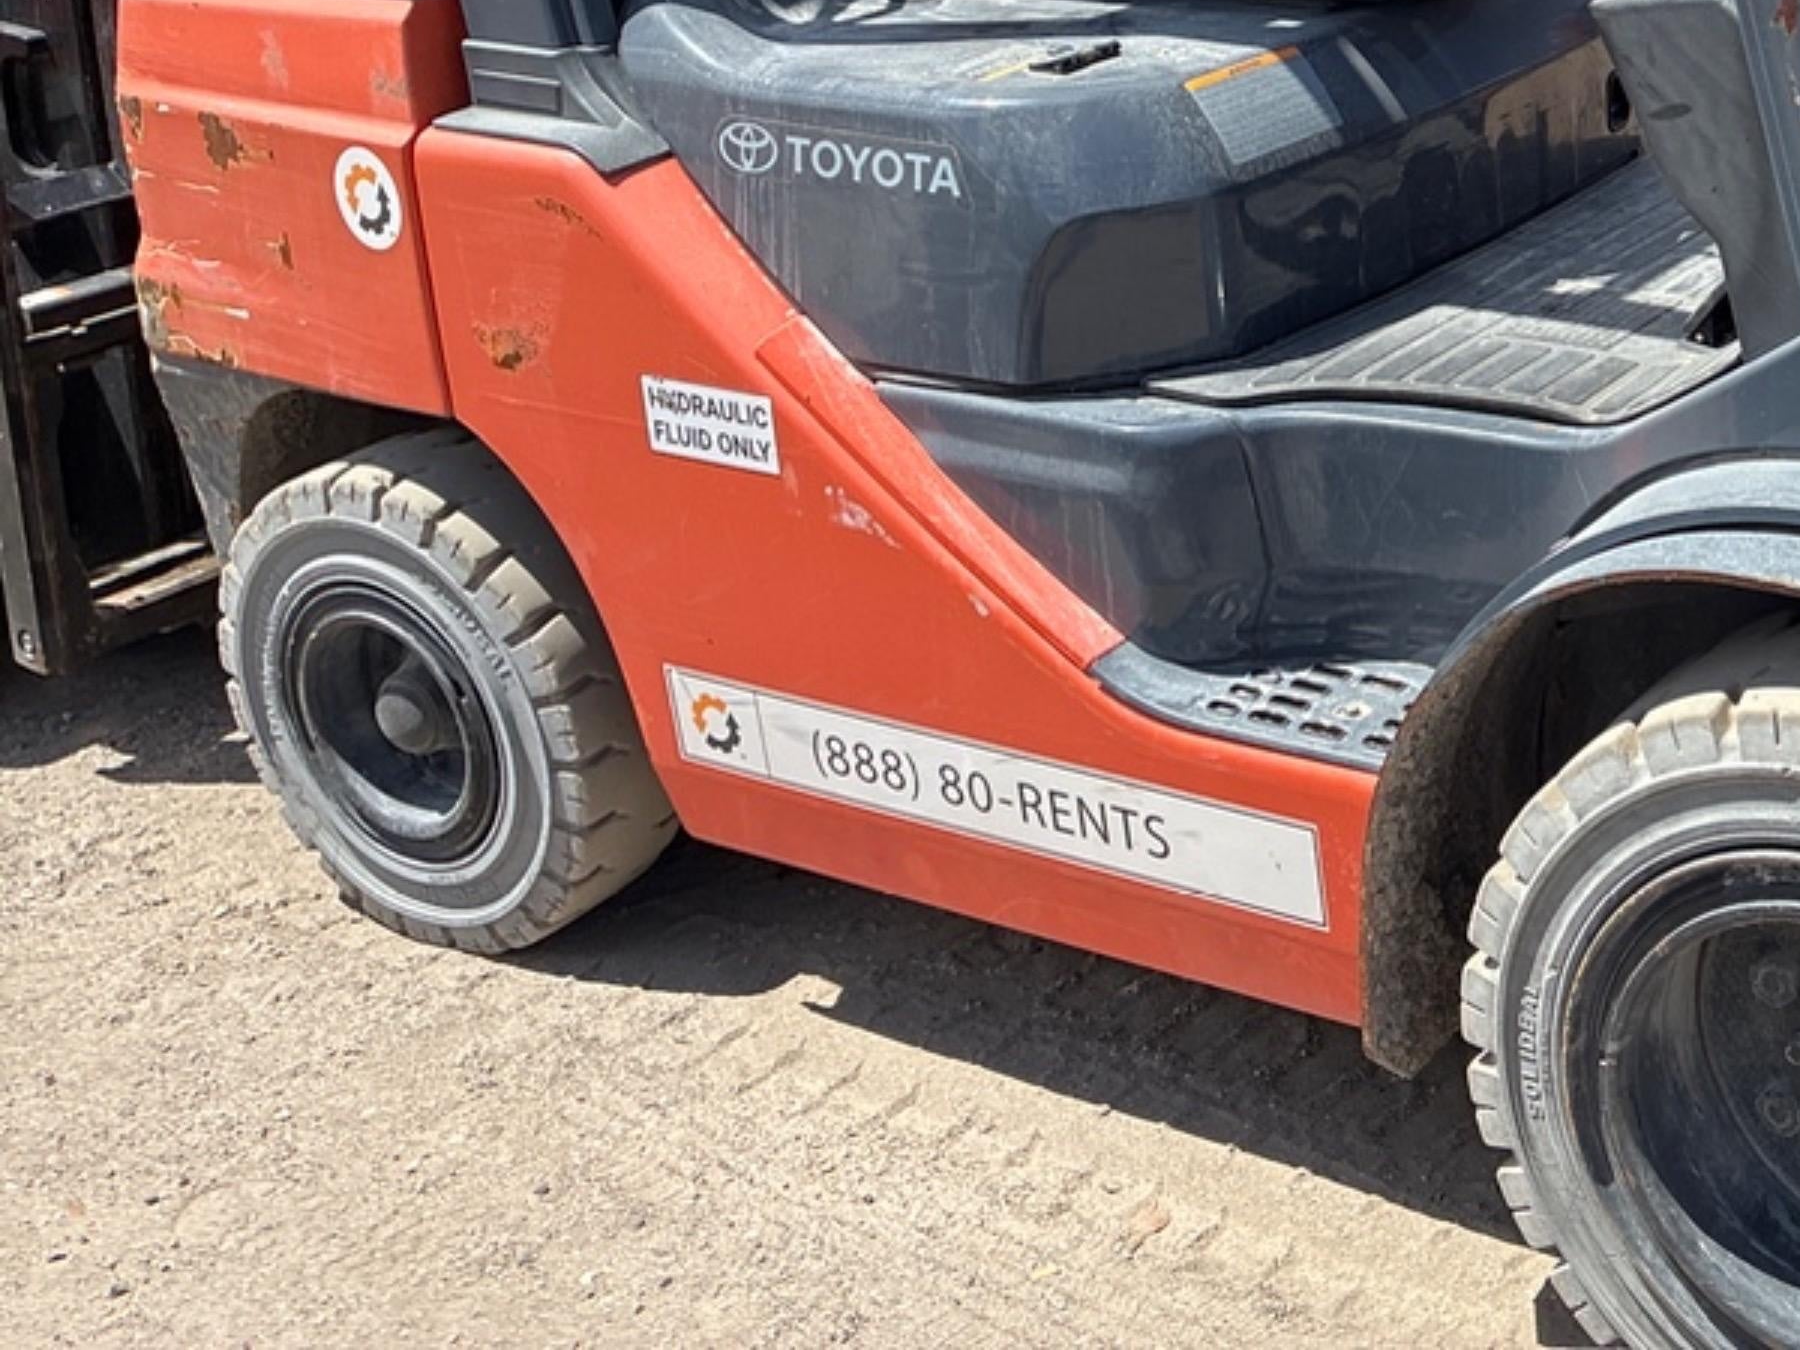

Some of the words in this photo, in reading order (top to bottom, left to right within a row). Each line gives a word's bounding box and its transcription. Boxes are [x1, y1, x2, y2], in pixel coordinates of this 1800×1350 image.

[785, 135, 962, 198] TOYOTA
[652, 418, 713, 451] FLUID
[716, 431, 771, 463] ONLY
[811, 728, 920, 802] (888)
[937, 763, 1172, 860] 80-RENTS
